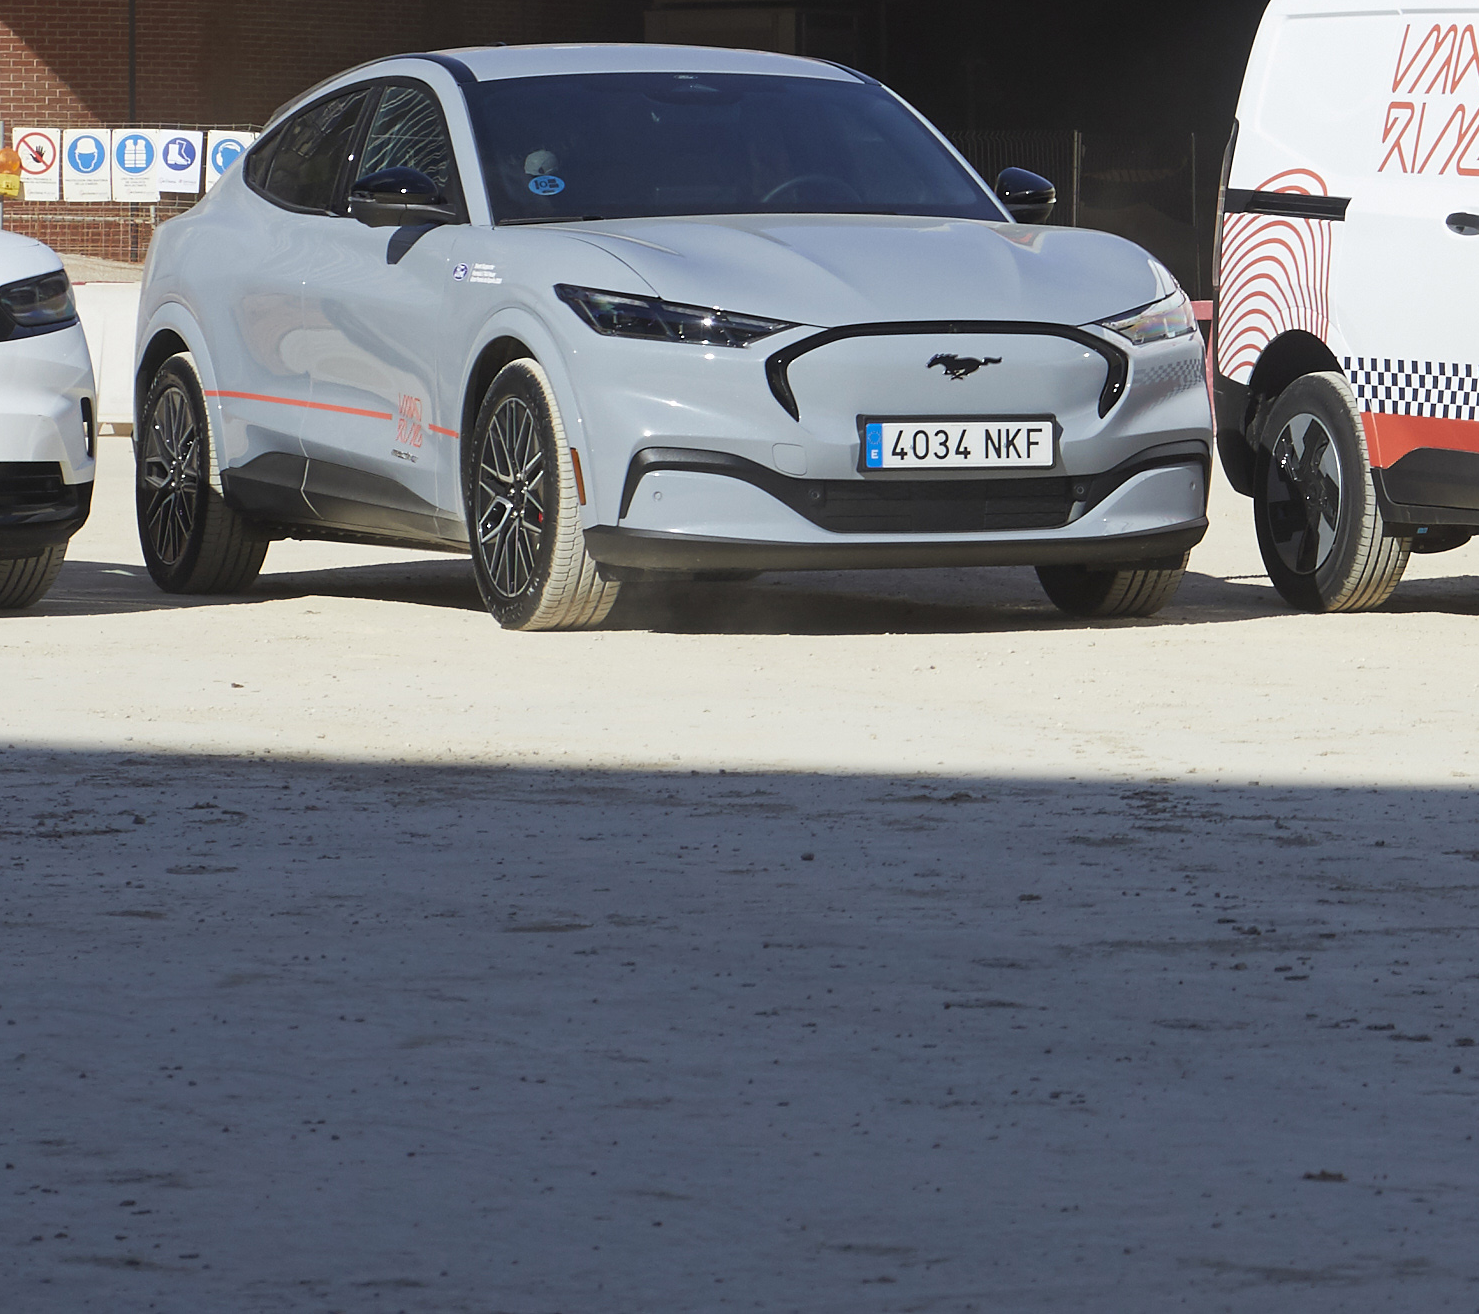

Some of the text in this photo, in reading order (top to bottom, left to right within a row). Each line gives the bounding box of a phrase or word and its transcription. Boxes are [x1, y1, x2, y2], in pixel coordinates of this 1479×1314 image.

[871, 428, 1043, 460] E 4034 NKF
